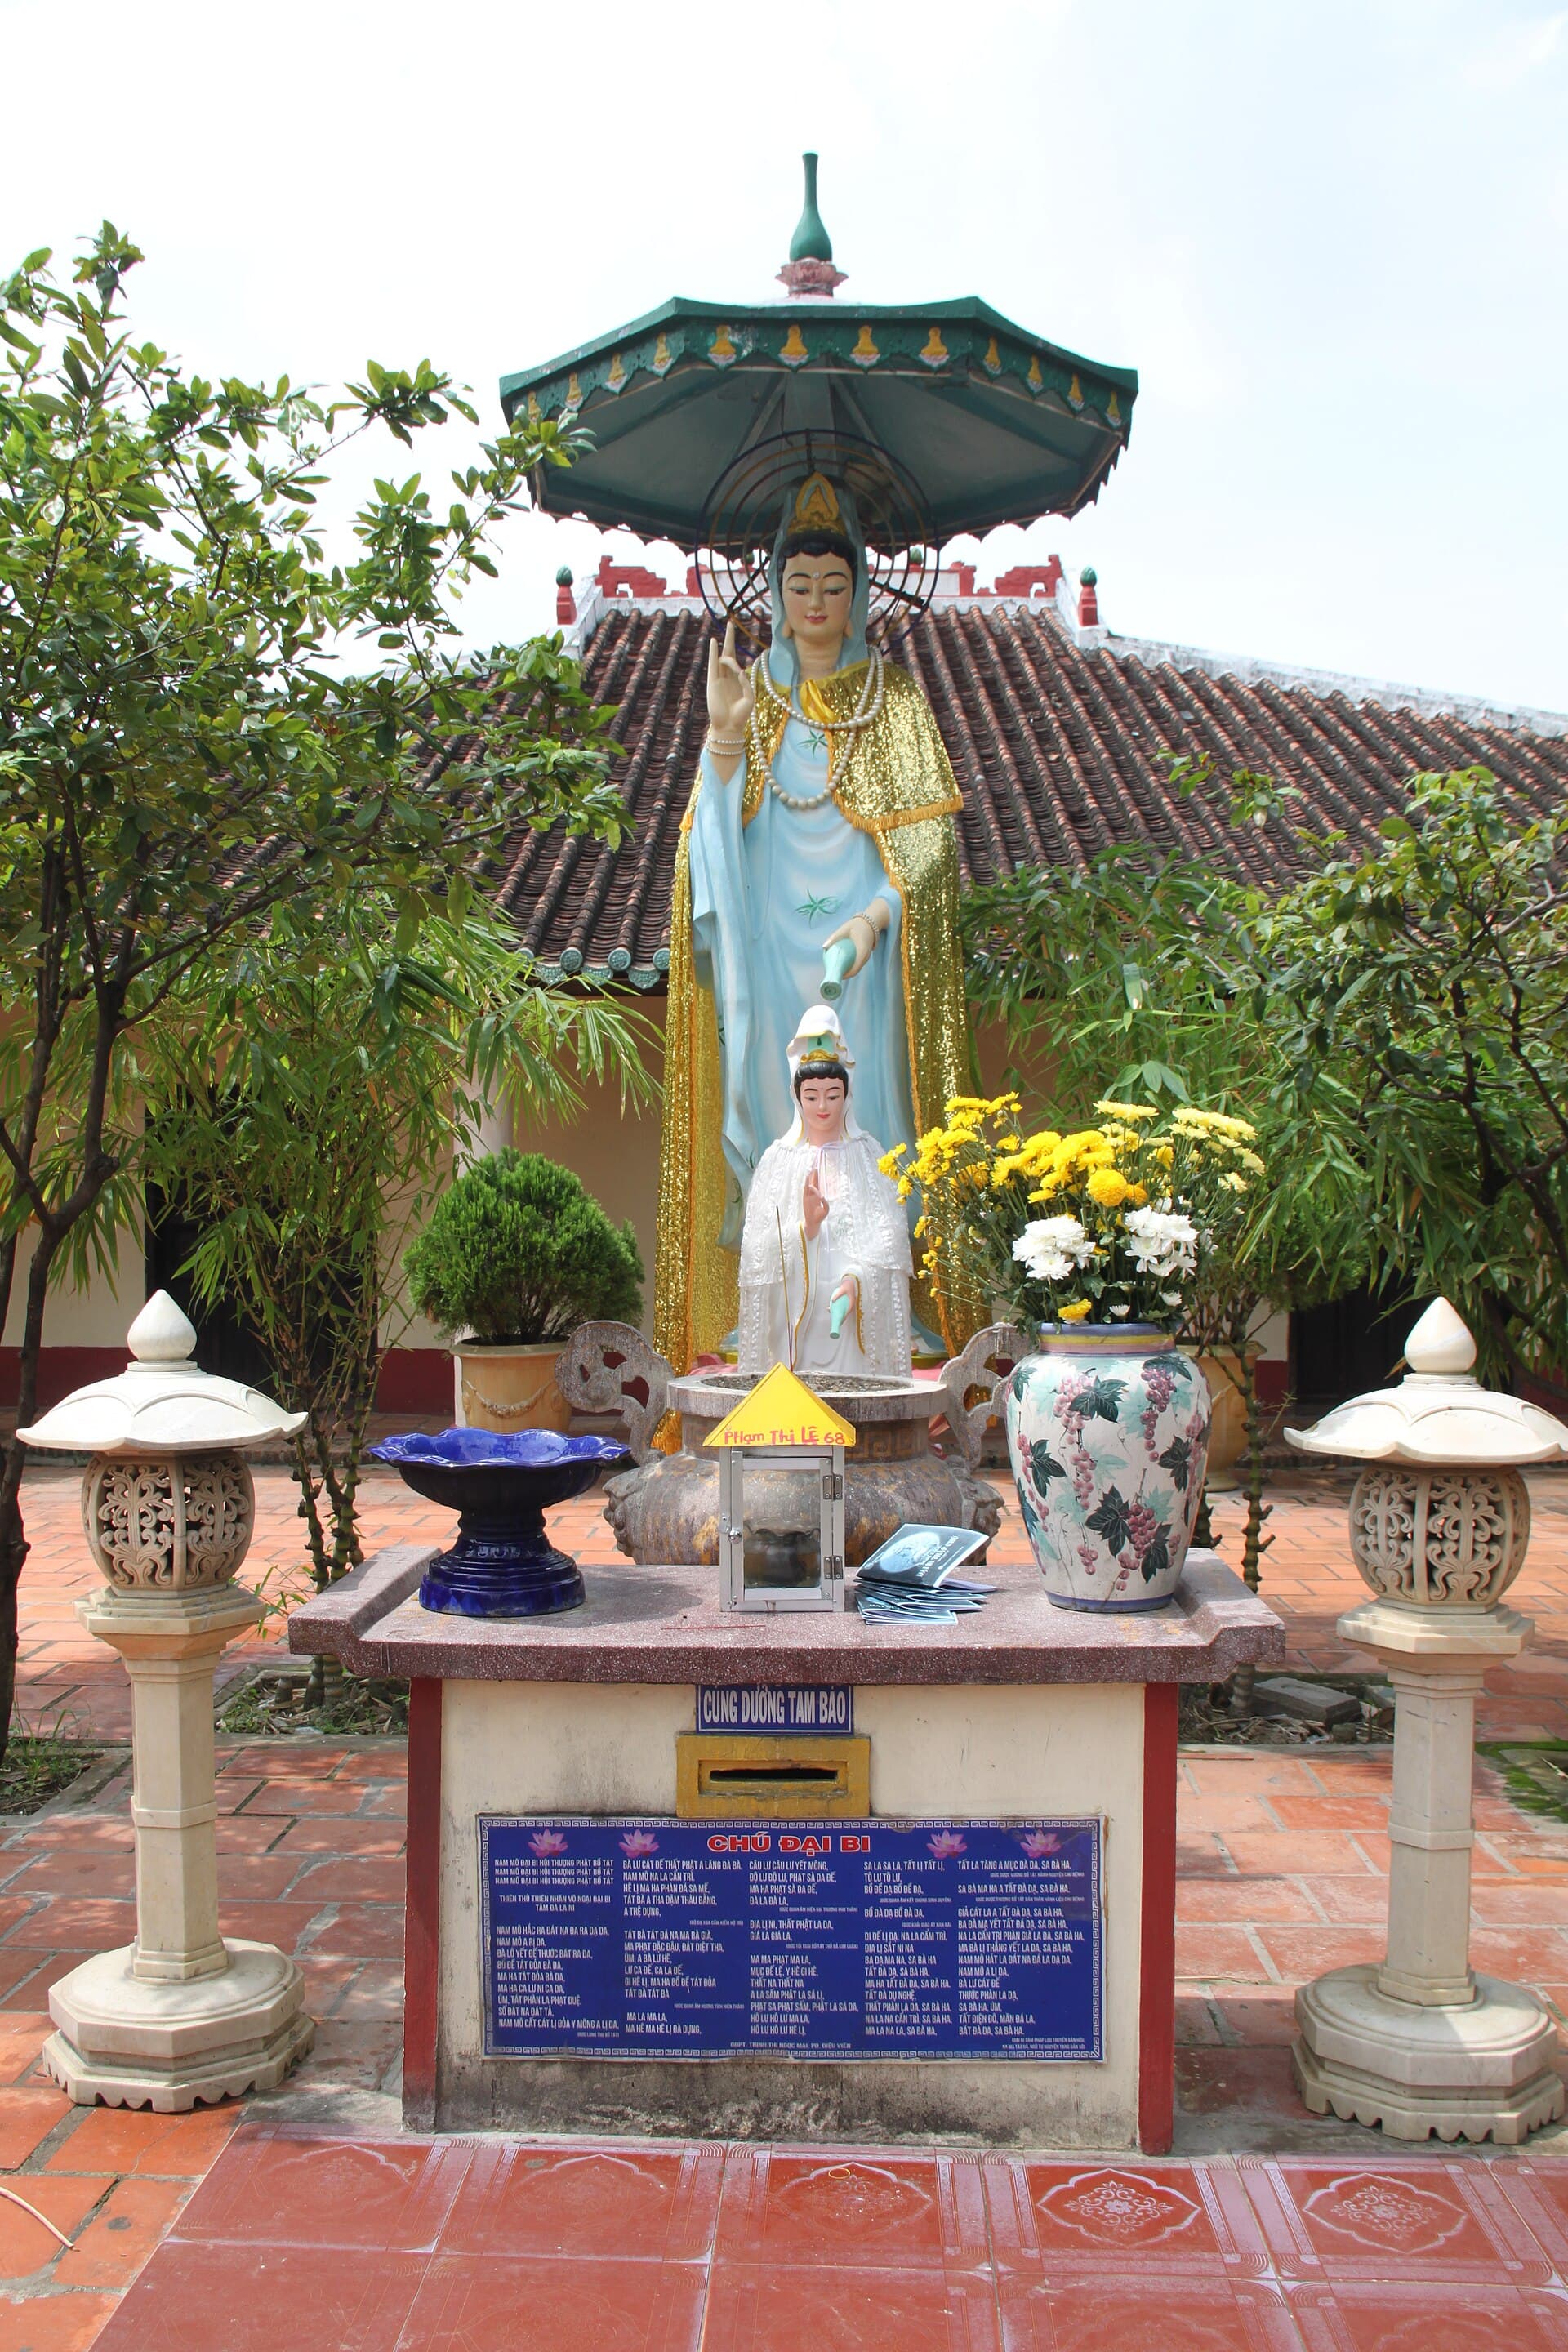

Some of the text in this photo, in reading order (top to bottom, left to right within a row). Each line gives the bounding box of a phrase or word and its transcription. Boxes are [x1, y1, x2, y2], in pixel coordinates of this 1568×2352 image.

[823, 1432, 845, 1445] 68
[787, 1690, 816, 1724] TAM
[707, 1832, 871, 1857] CHÚ ĐẠI BI
[494, 1859, 509, 1867] NAM
[532, 1859, 538, 1867] BI
[863, 1861, 873, 1871] SA
[873, 1861, 882, 1871] LA
[882, 1861, 892, 1871] SA
[646, 1895, 651, 1904] A
[652, 1895, 665, 1904] THA
[760, 1896, 768, 1905] LA
[559, 1904, 568, 1912] LA
[568, 1904, 575, 1912] NI
[496, 1926, 511, 1935] NAM
[537, 1926, 546, 1935] RA
[559, 1926, 569, 1935] NA
[579, 1926, 589, 1935] RA
[670, 1931, 679, 1940] NA
[679, 1931, 690, 1940] MA
[761, 1931, 770, 1940] LA
[496, 1937, 511, 1946] NAM
[523, 1937, 528, 1946] A
[750, 1955, 760, 1964] MA
[760, 1955, 772, 1964] MA
[790, 1955, 800, 1964] MA
[864, 1955, 874, 1965] BA
[884, 1955, 895, 1965] MA
[907, 1955, 917, 1965] SA
[927, 1955, 937, 1965] HA
[958, 1967, 973, 1976] NAM
[985, 1967, 991, 1976] A
[497, 1972, 508, 1981] MA
[508, 1972, 518, 1981] HA
[768, 1979, 777, 1988] NA
[795, 1979, 804, 1988] NA
[497, 1984, 508, 1993] MA
[509, 1984, 518, 1993] HA
[519, 1984, 528, 1993] CA
[537, 1984, 544, 1993] NI
[545, 1984, 554, 1993] CA
[998, 1990, 1007, 2000] LA
[958, 2002, 968, 2012] SA
[626, 2012, 637, 2021] MA
[637, 2012, 646, 2021] LA
[647, 2012, 657, 2021] MA
[788, 2014, 800, 2023] MA
[865, 2026, 875, 2036] MA
[876, 2026, 885, 2036] LA
[885, 2026, 895, 2036] NA
[906, 2026, 915, 2036] SA
